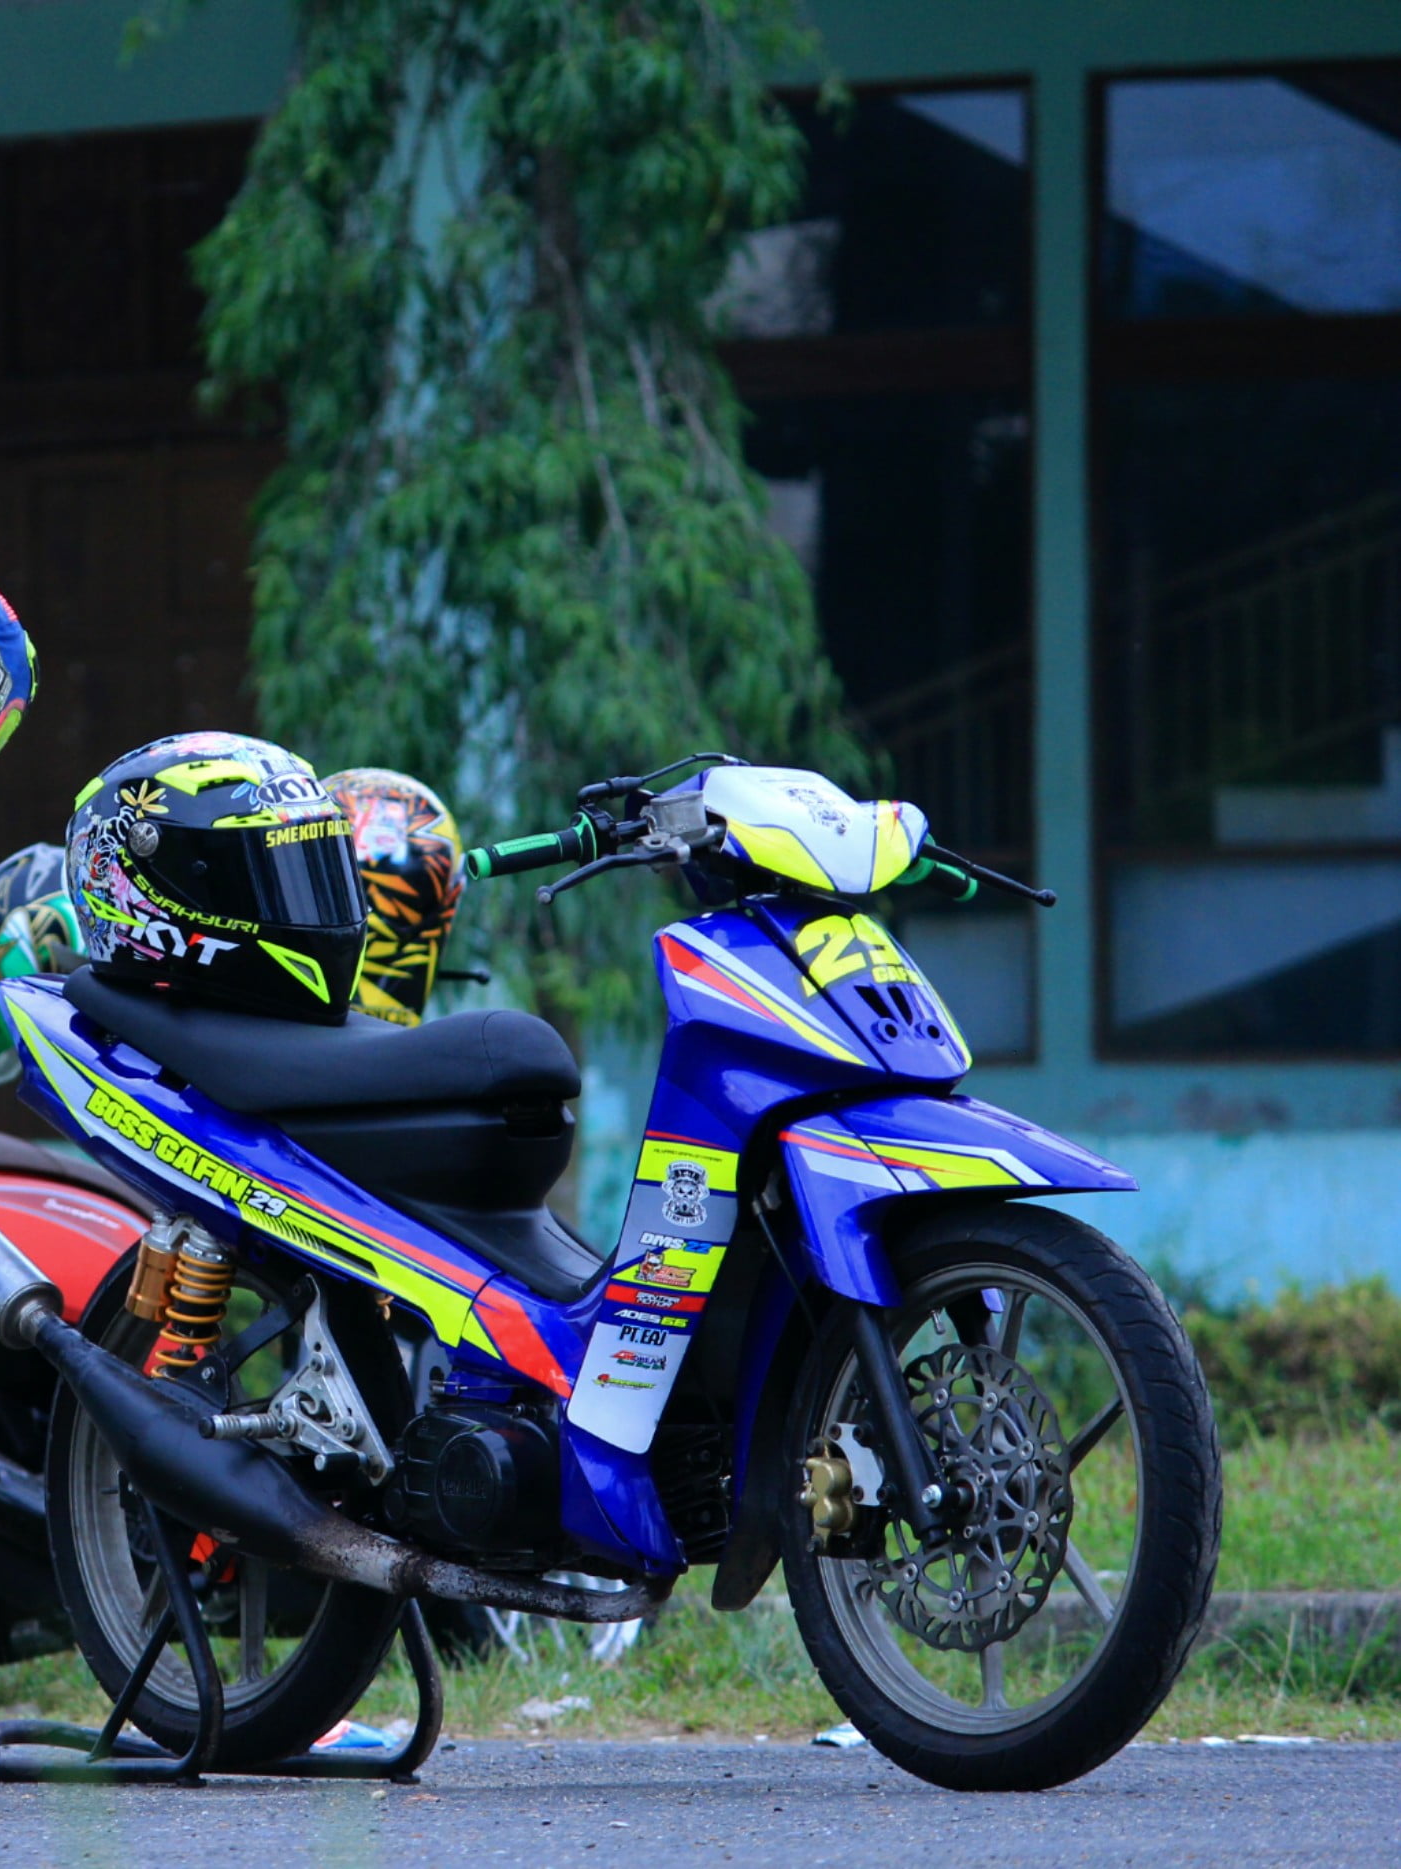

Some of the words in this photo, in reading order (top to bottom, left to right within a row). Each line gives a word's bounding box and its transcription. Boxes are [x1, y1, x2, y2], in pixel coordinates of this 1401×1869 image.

[266, 822, 325, 848] SMEKOT
[130, 908, 241, 966] KYT
[86, 1088, 158, 1150] BOSS
[247, 1189, 290, 1217] 29
